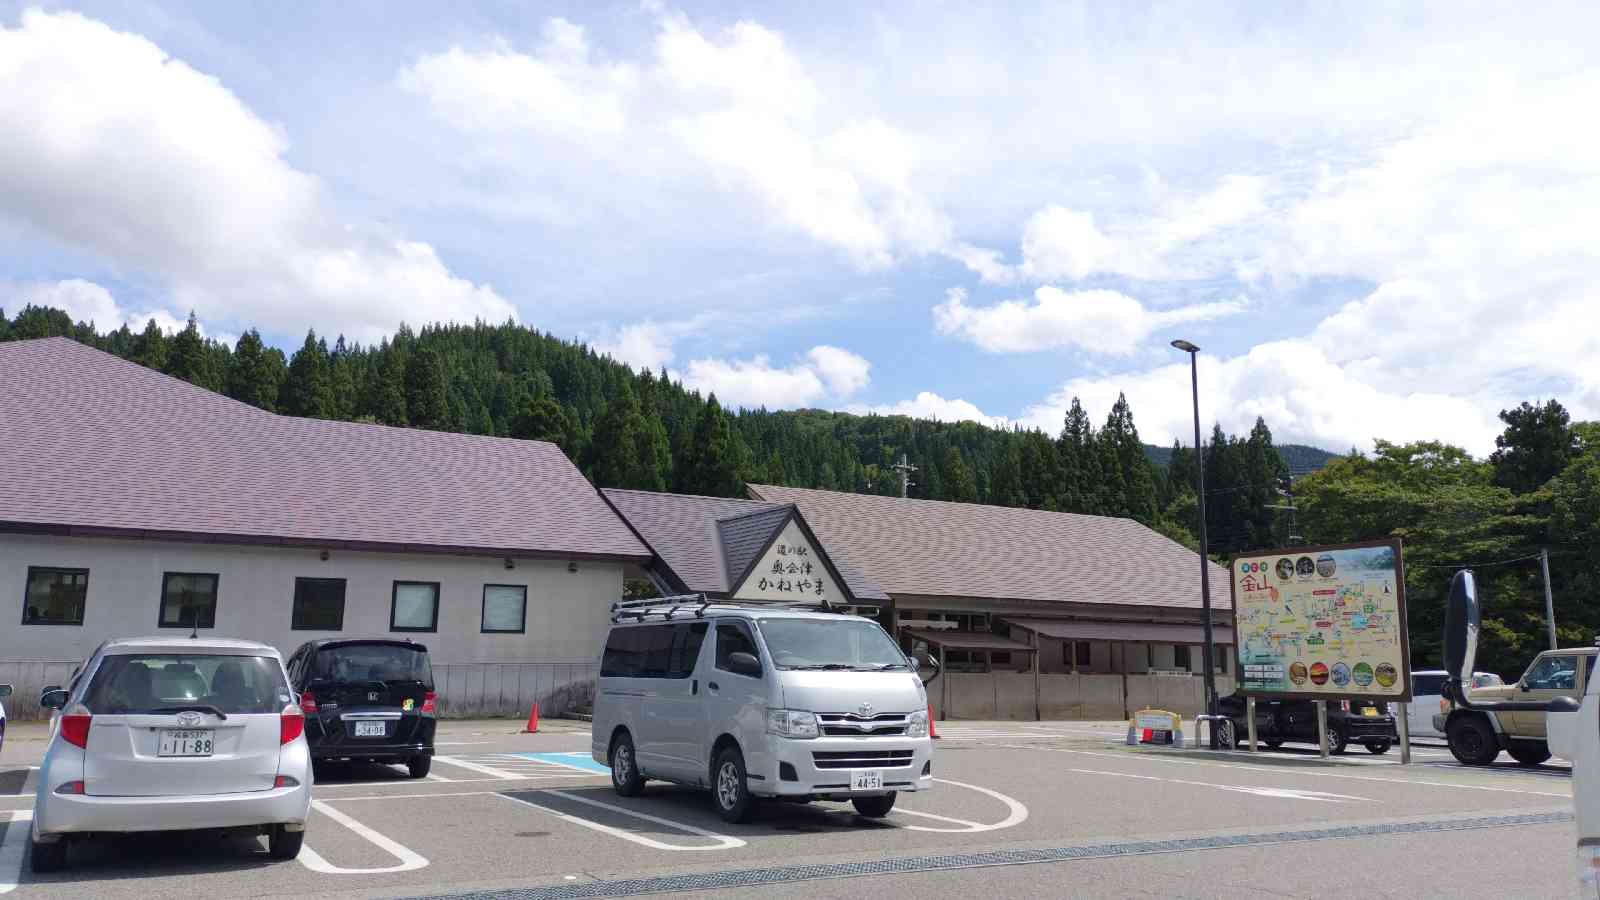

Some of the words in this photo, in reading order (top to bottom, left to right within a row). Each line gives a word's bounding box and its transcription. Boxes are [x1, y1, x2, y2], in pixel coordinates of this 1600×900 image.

[771, 560, 812, 575] 奥会津
[758, 578, 824, 595] かねやま
[1240, 575, 1272, 591] 金山
[173, 740, 211, 752] 11-88
[857, 778, 880, 788] 44-51
